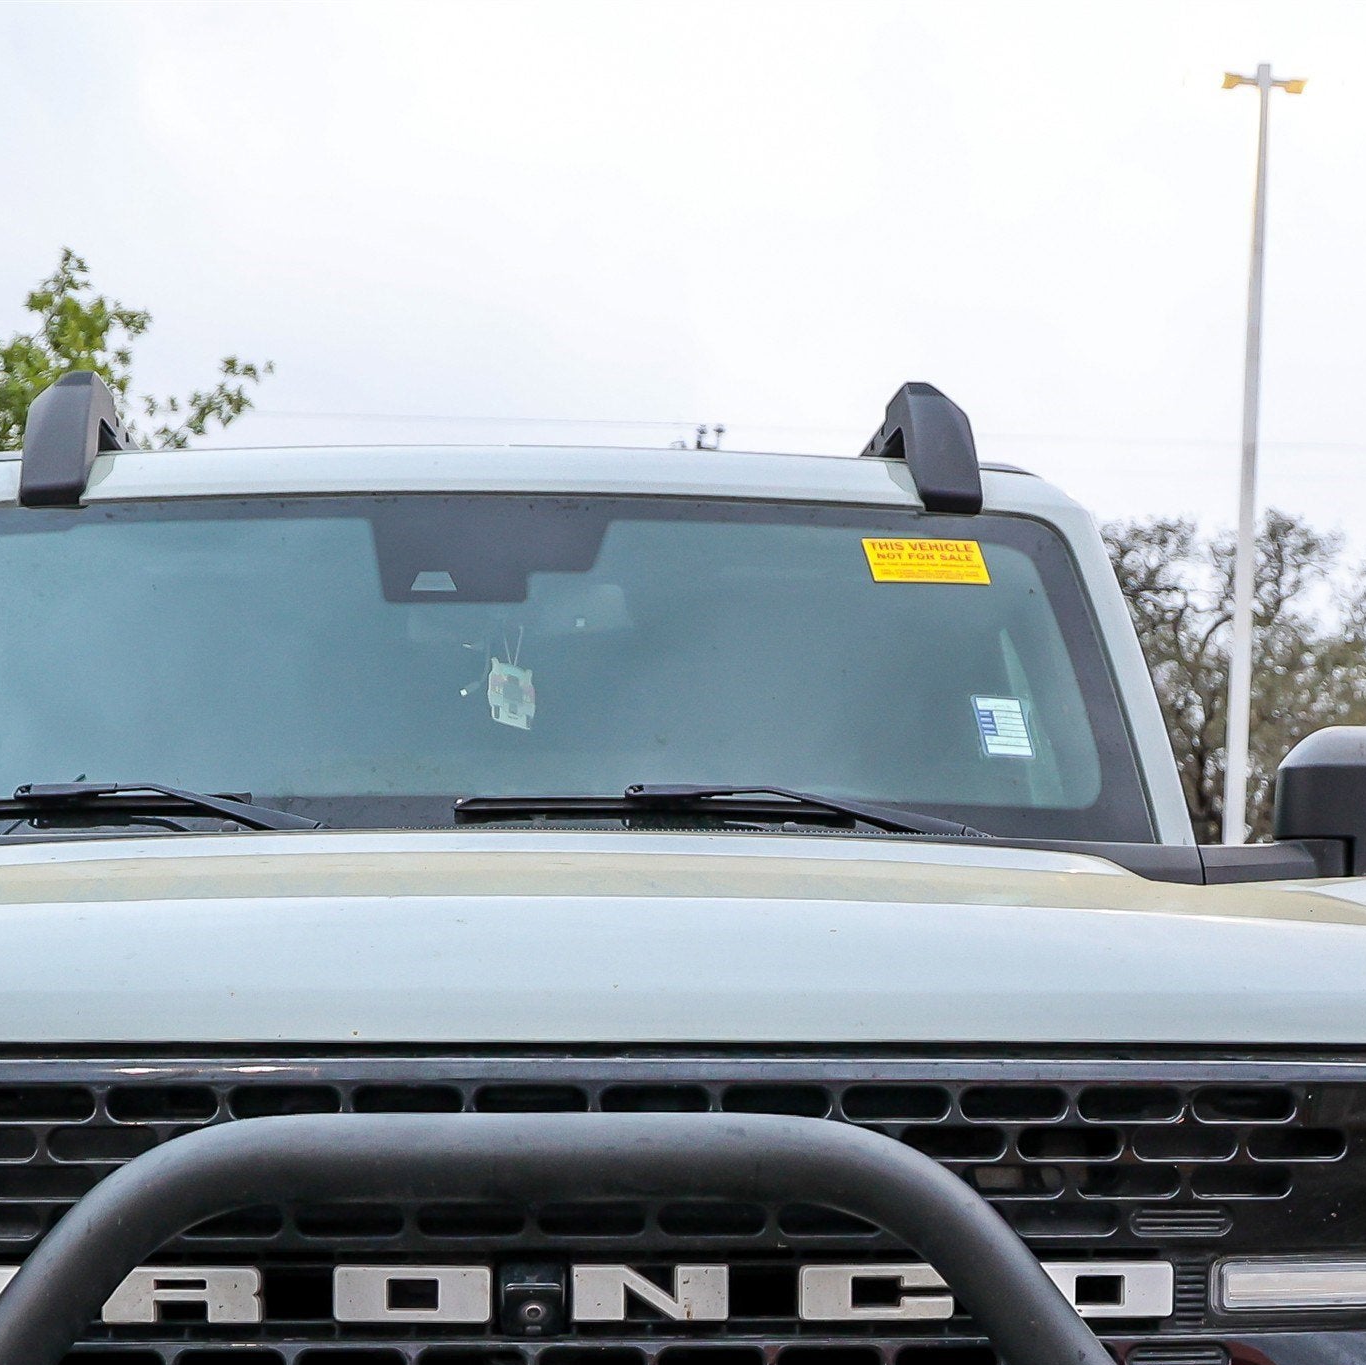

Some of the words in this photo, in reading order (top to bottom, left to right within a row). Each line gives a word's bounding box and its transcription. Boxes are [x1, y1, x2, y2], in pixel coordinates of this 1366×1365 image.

[869, 541, 904, 551] THIS
[908, 542, 974, 553] VEHICLE
[940, 553, 973, 561] SALE
